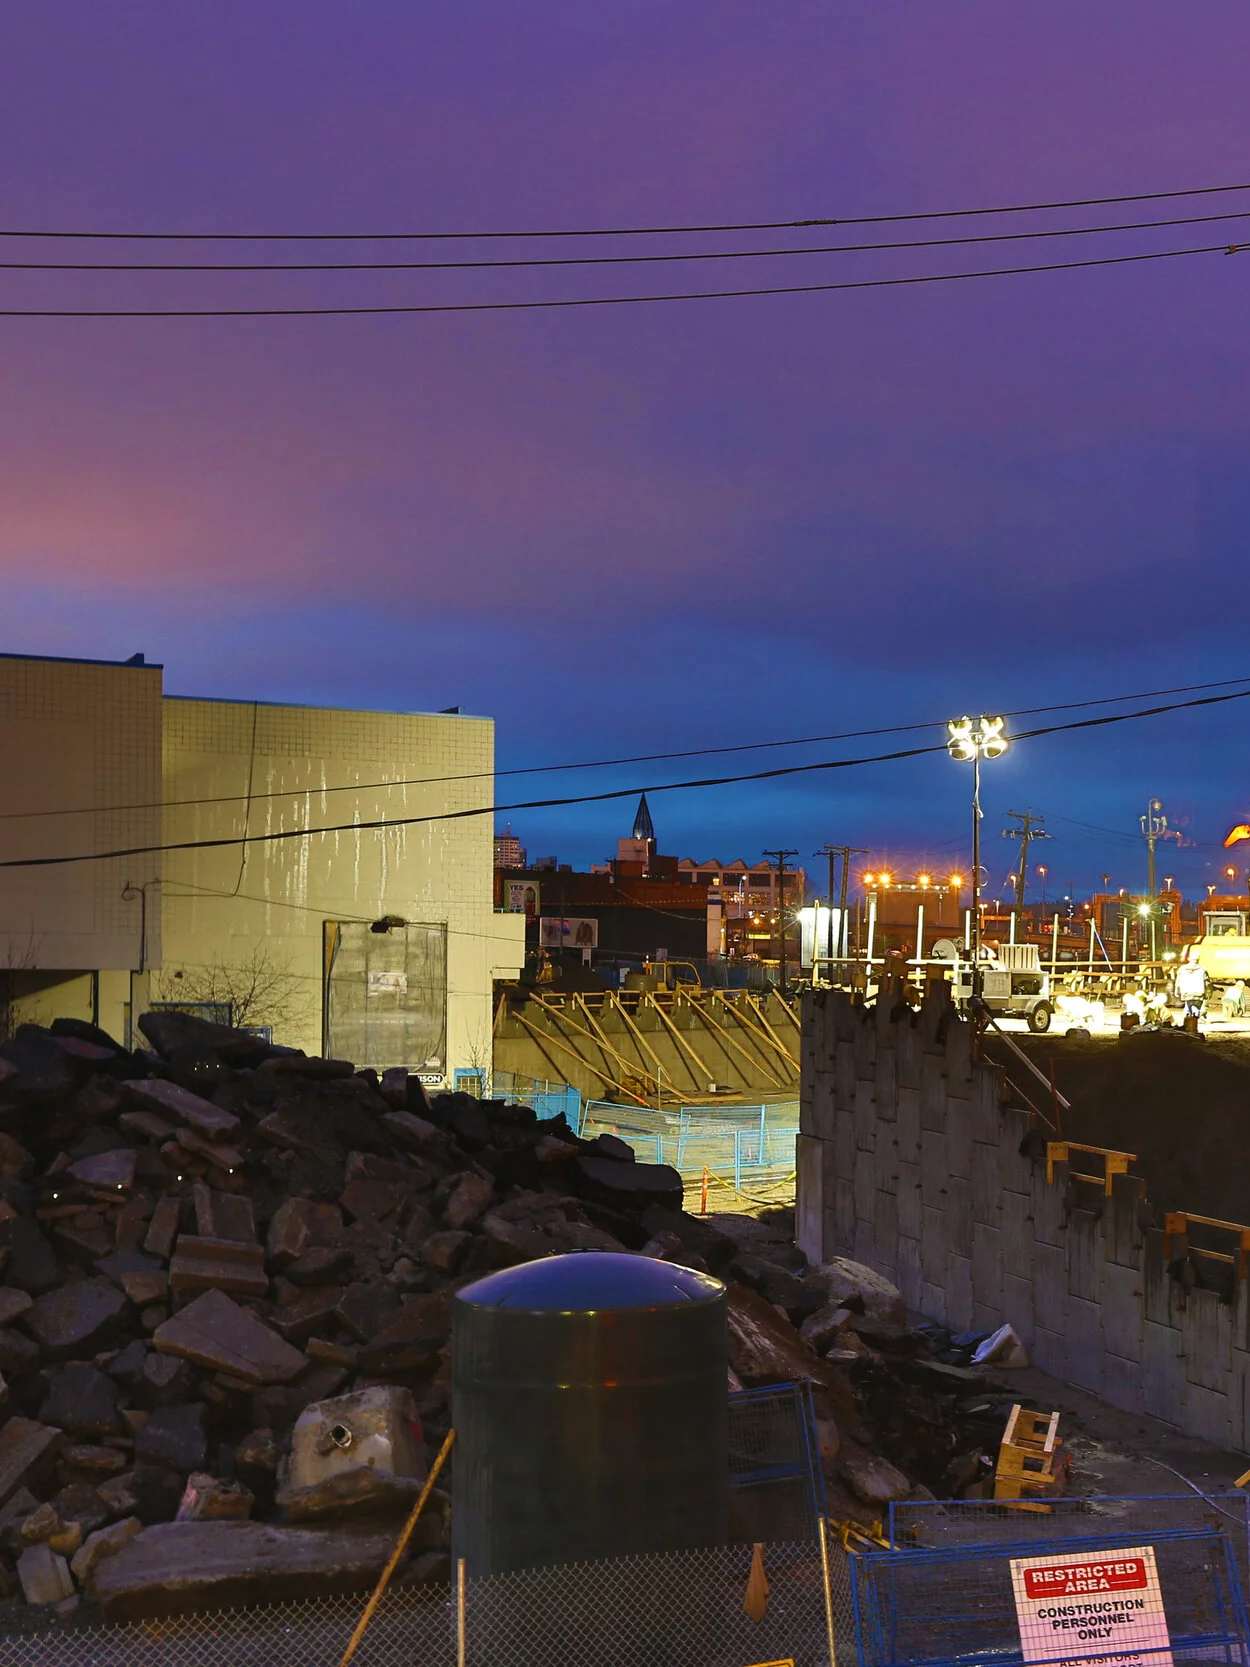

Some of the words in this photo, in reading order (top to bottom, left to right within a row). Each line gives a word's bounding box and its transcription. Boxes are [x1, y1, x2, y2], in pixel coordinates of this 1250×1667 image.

[417, 1075, 441, 1083] ISON
[1032, 1562, 1138, 1584] RESTRICTED
[1065, 1580, 1110, 1593] AREA
[1038, 1598, 1144, 1619] CONSTRUCTION
[1052, 1613, 1134, 1631] PERSONNEL
[1078, 1627, 1112, 1640] ONLY
